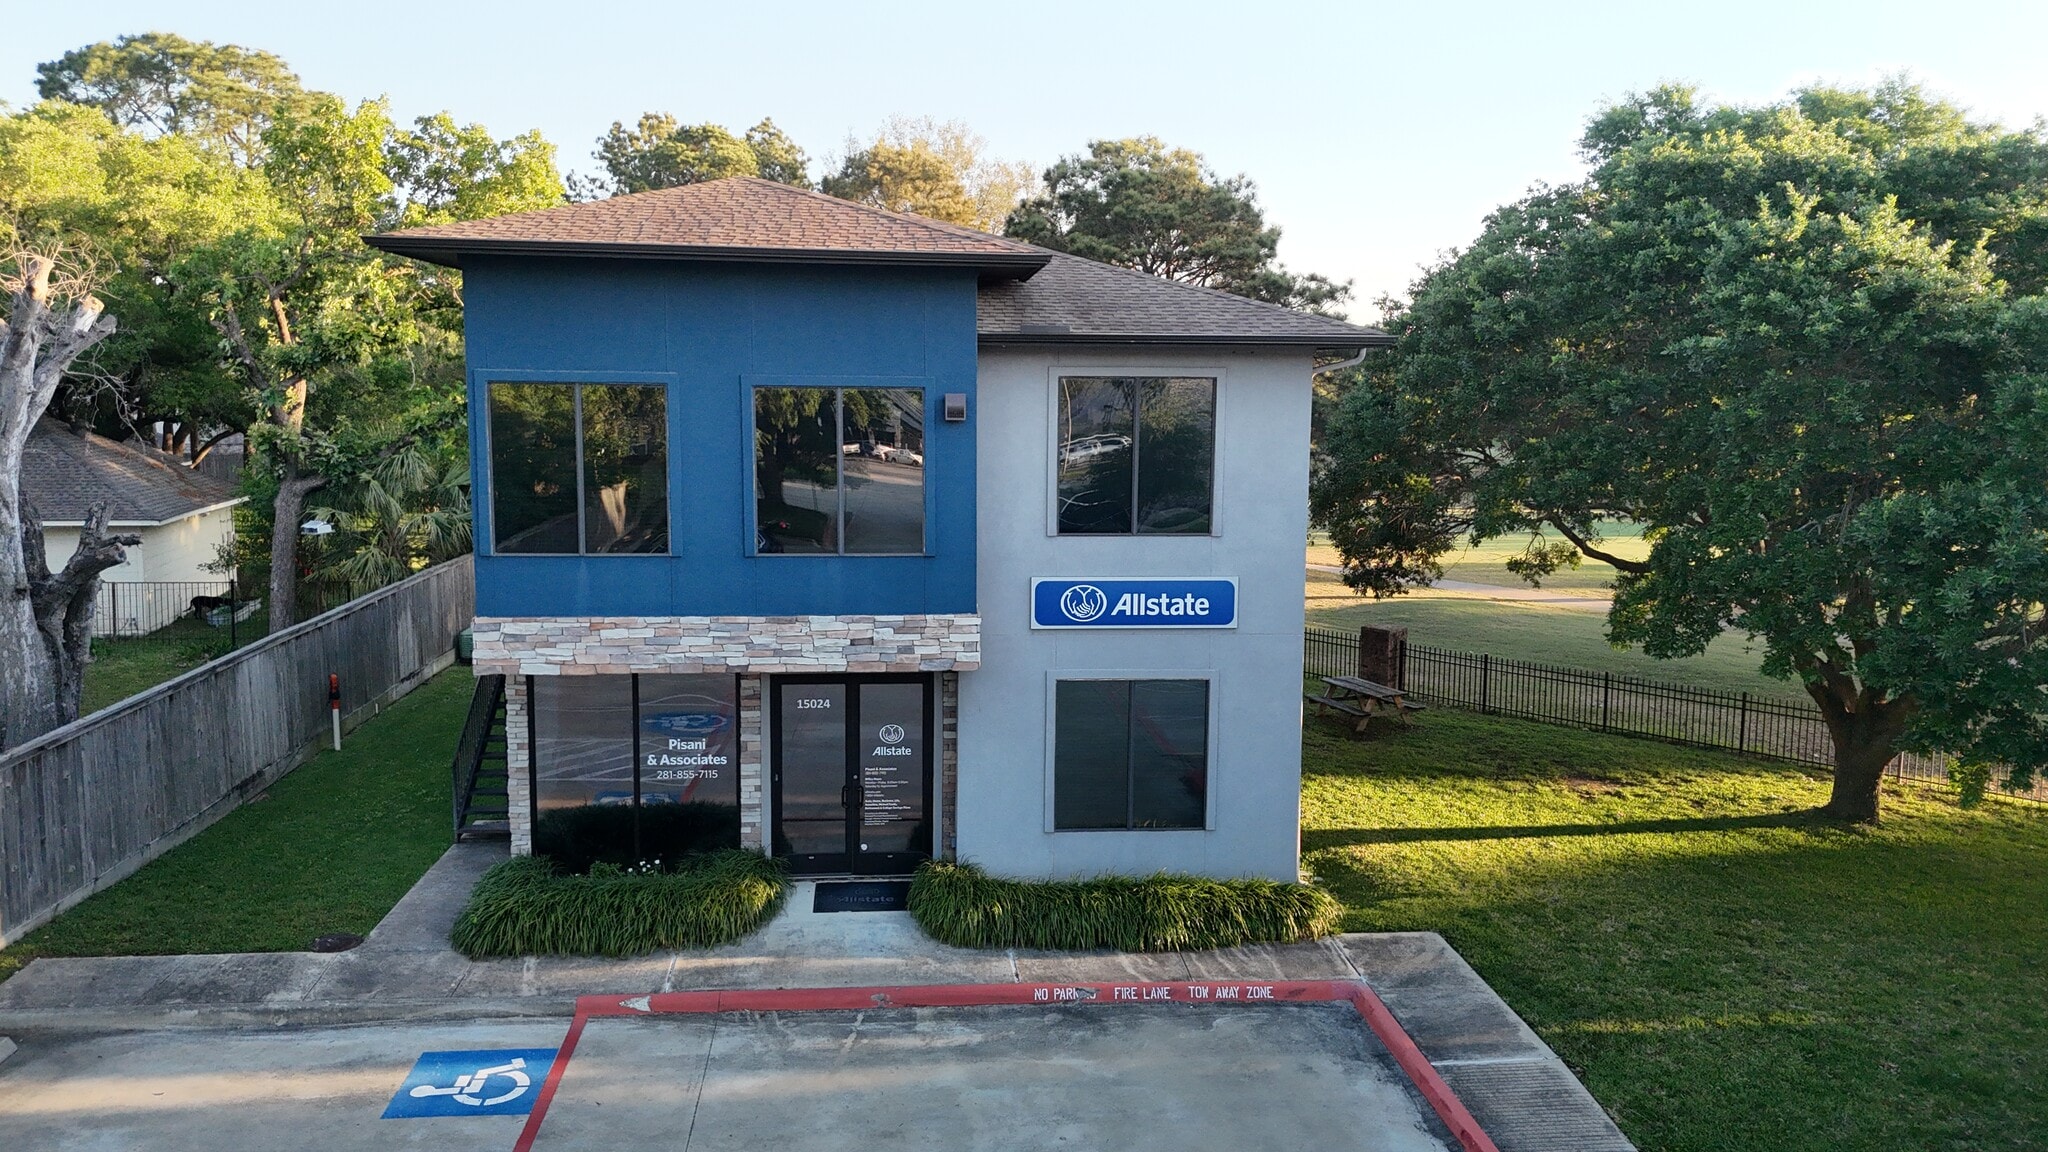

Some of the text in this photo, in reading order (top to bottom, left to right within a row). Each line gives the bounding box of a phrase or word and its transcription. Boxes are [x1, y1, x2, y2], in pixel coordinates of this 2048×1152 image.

[1111, 593, 1209, 616] Allstate
[797, 699, 830, 709] 15024
[668, 739, 706, 750] Pisani
[873, 747, 911, 756] Allstate
[647, 753, 727, 766] & Associates
[657, 769, 718, 780] 281-855-7115
[1034, 985, 1274, 1000] NO PARK FIRE LANE TOW AWAY ZONE
